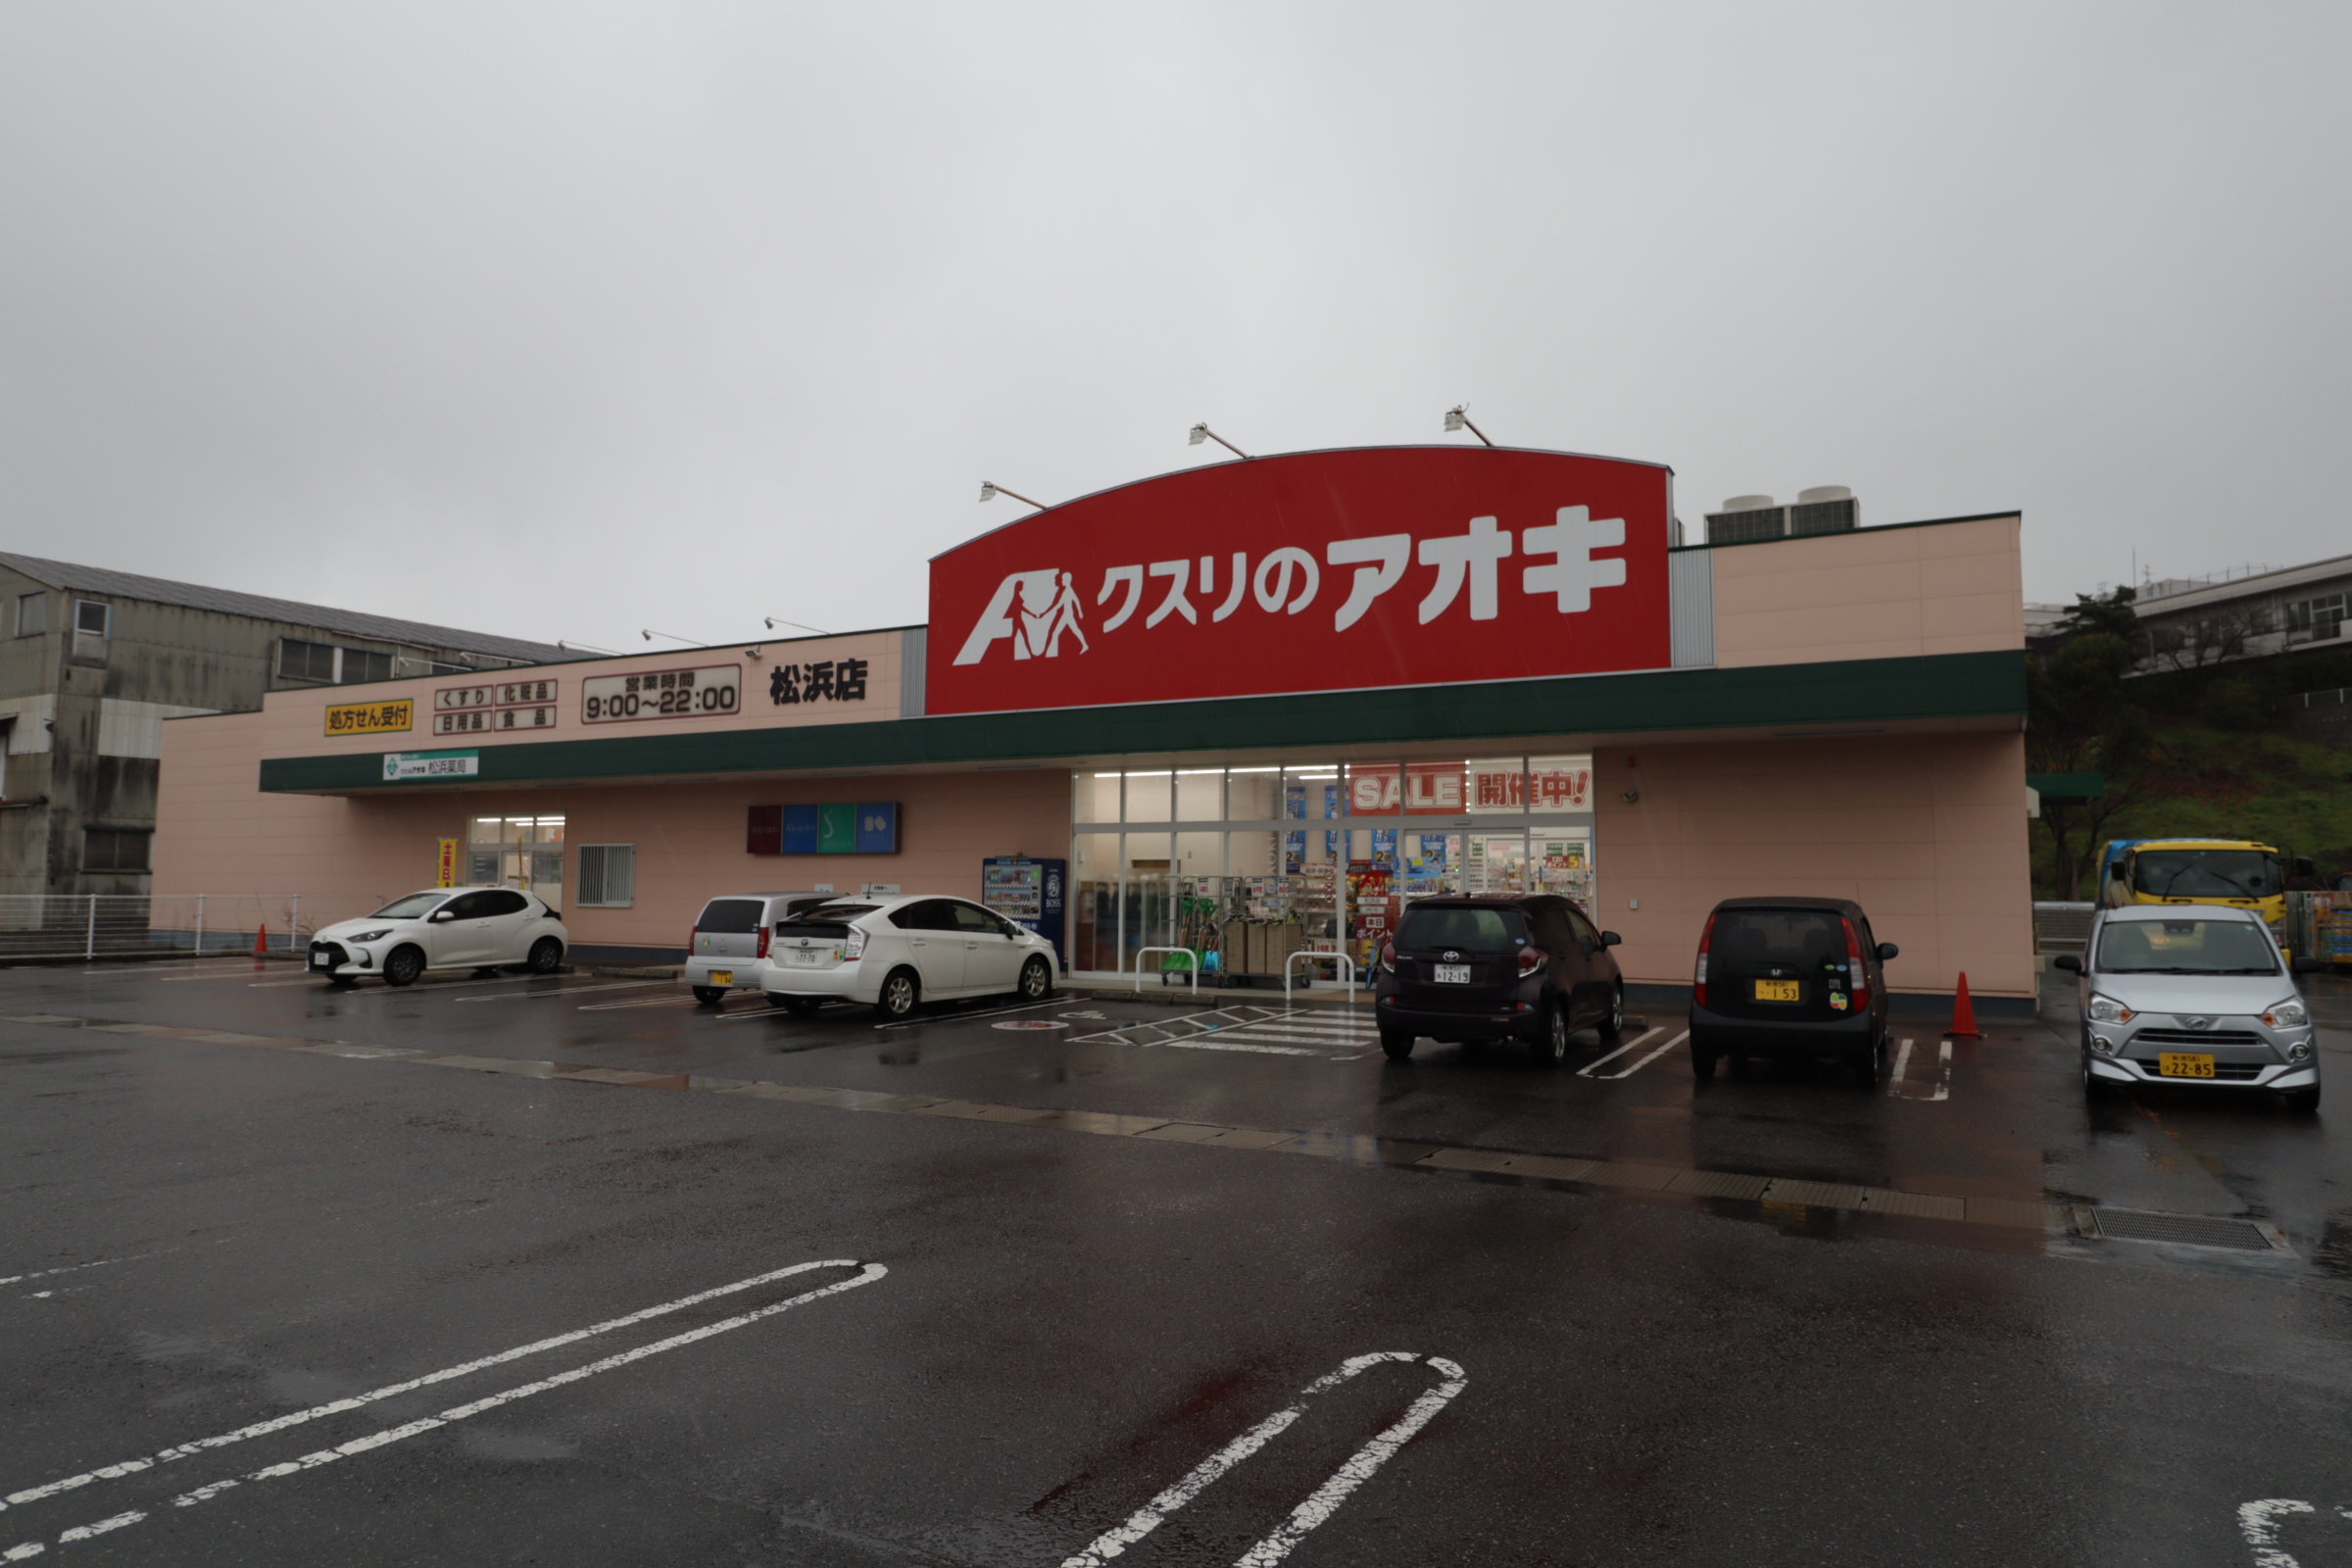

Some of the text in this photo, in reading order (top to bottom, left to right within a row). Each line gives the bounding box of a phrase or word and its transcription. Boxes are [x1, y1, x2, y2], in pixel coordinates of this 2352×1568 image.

[1097, 504, 1627, 633] クスリのアオキ
[625, 671, 695, 692] 営業時間
[770, 659, 868, 706] 松浜店
[444, 690, 483, 706] くすり
[504, 683, 547, 703] 化粧品
[329, 705, 408, 730] 処方せん受付
[443, 712, 482, 731] 日用品
[504, 709, 546, 728] 食品
[428, 760, 466, 774] 松浜薬局
[1354, 775, 1461, 809] SALE
[1046, 899, 1060, 907] BOSS
[1367, 917, 1383, 927] 本日
[1356, 929, 1393, 939] ポイント
[2172, 1062, 2212, 1076] 22-85
